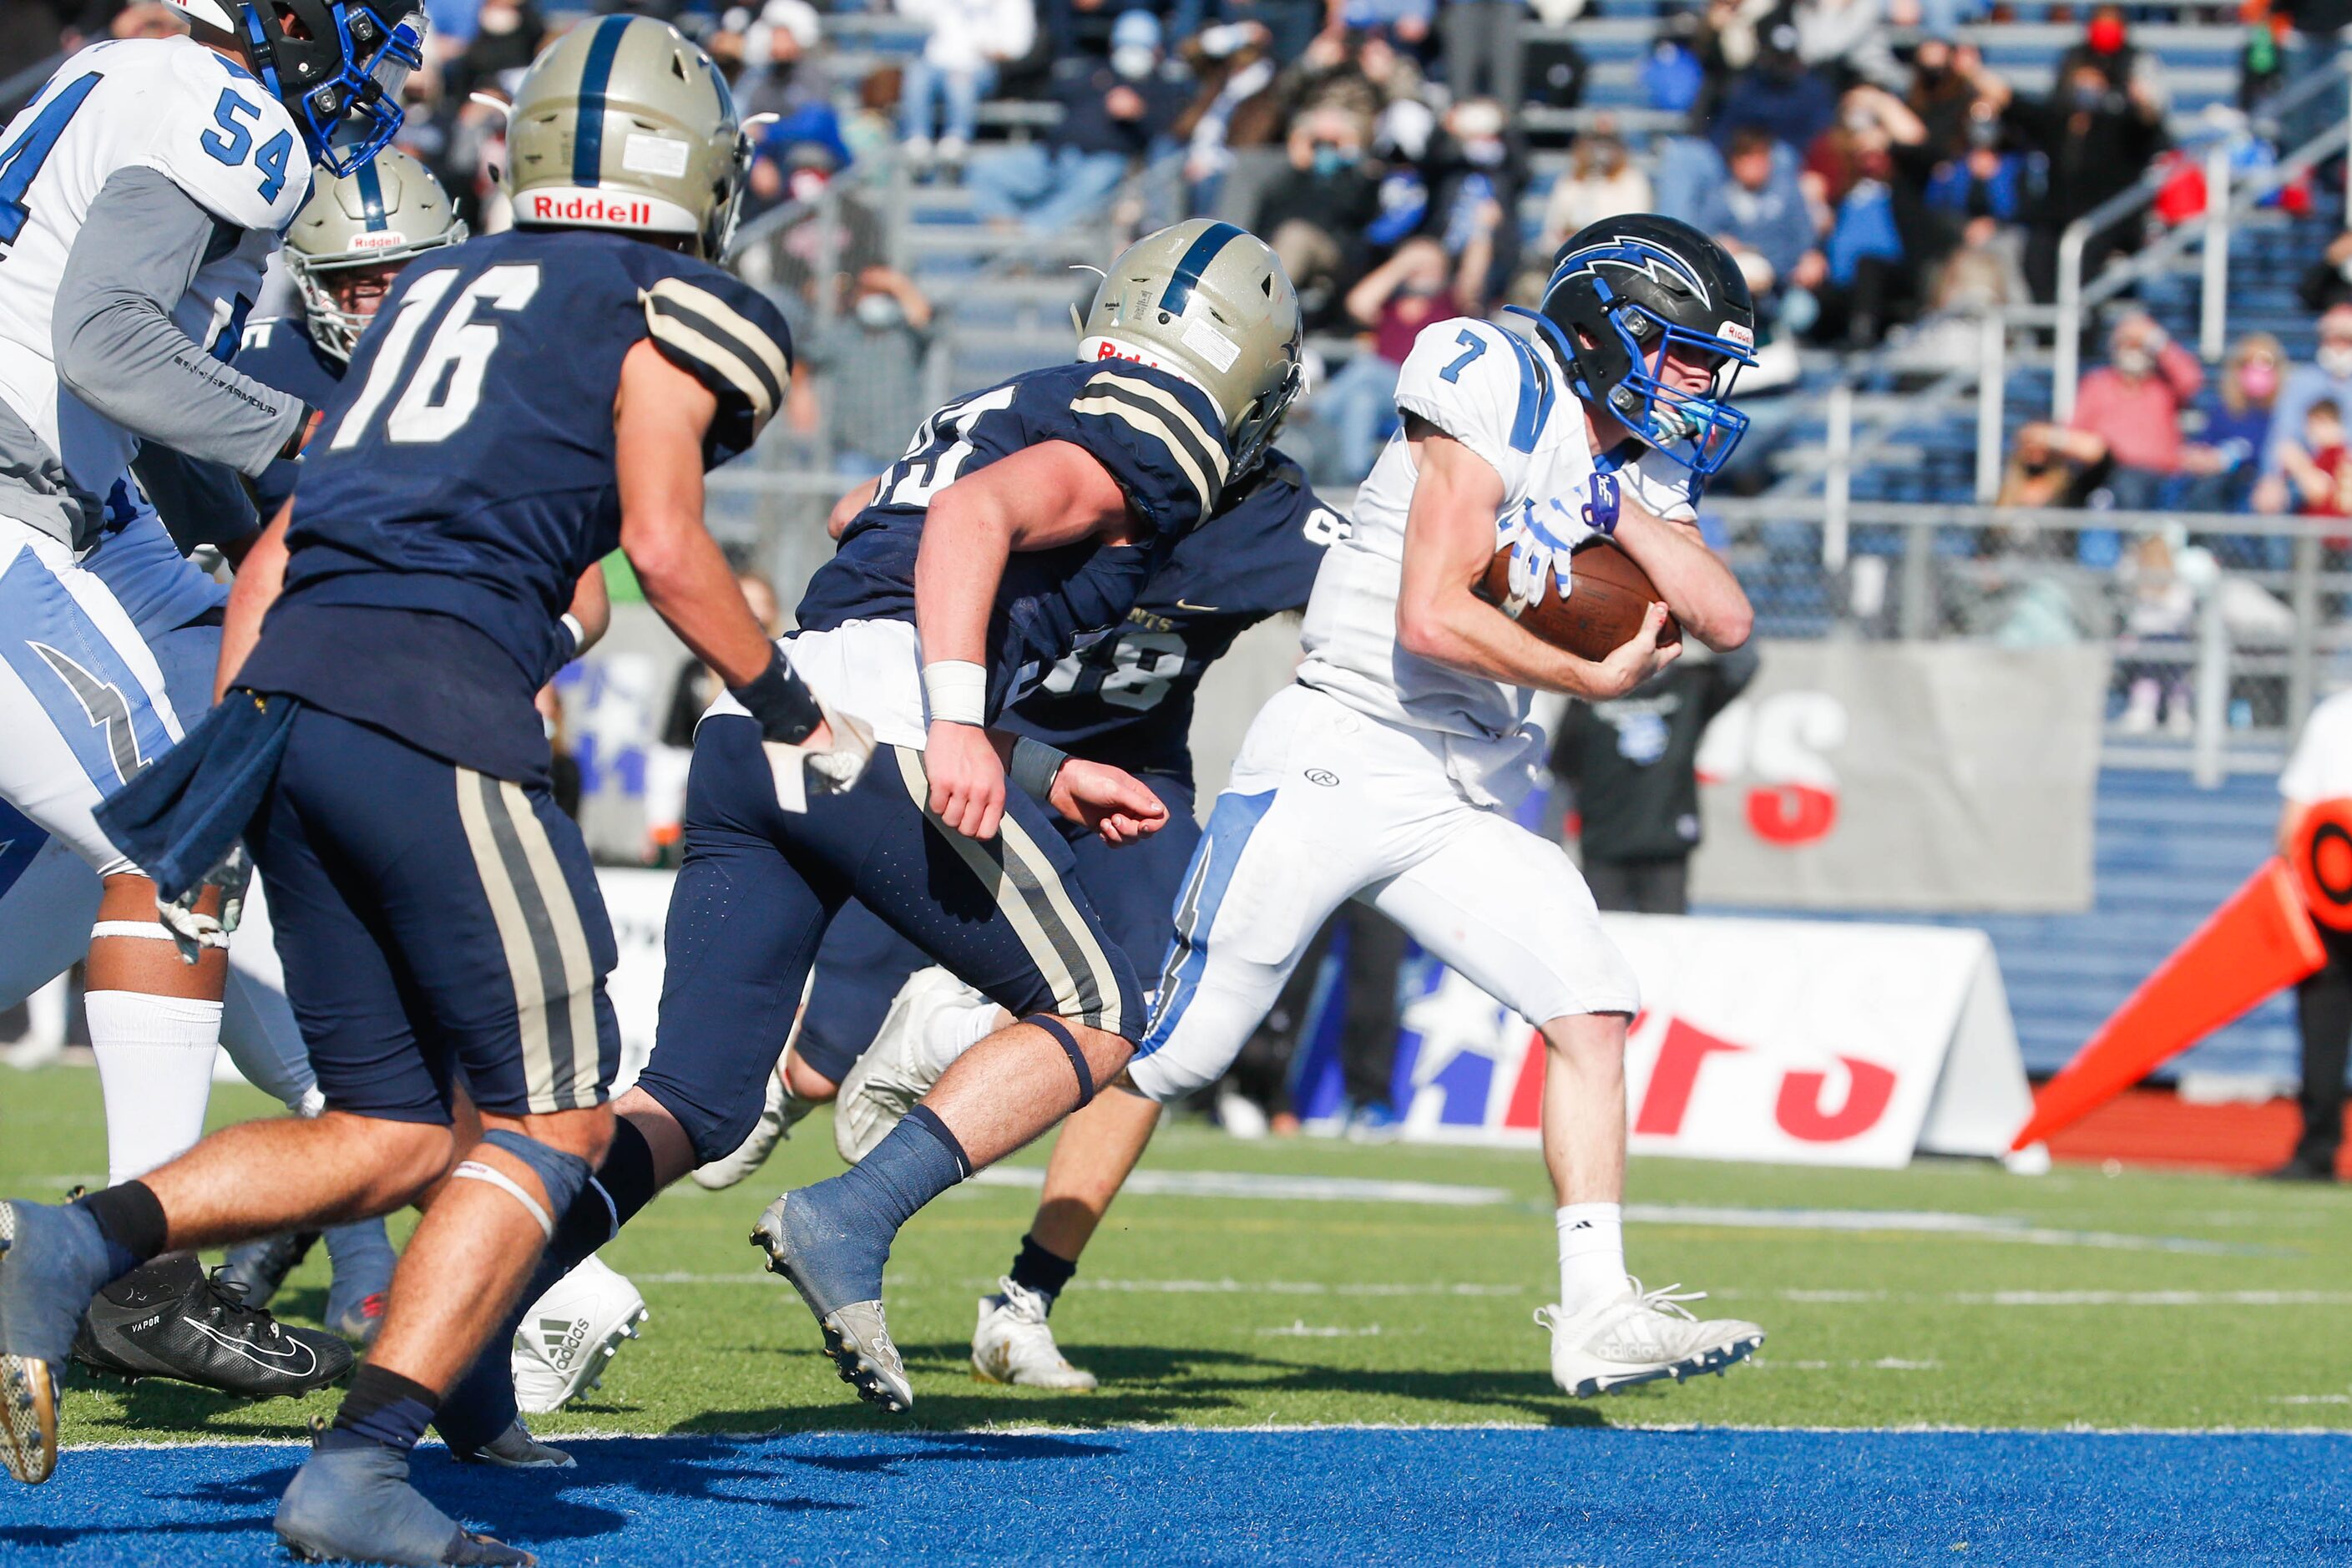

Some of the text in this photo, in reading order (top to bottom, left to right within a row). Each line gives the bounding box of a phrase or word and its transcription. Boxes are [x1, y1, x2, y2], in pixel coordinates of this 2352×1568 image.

[200, 87, 294, 206] 54
[534, 195, 650, 225] Riddell
[355, 235, 401, 248] Riddell
[329, 264, 541, 450] 16
[1439, 328, 1487, 384] 7
[131, 1315, 159, 1333] VAPOR
[556, 1318, 589, 1370] adidas
[1596, 1343, 1664, 1360] adidas
